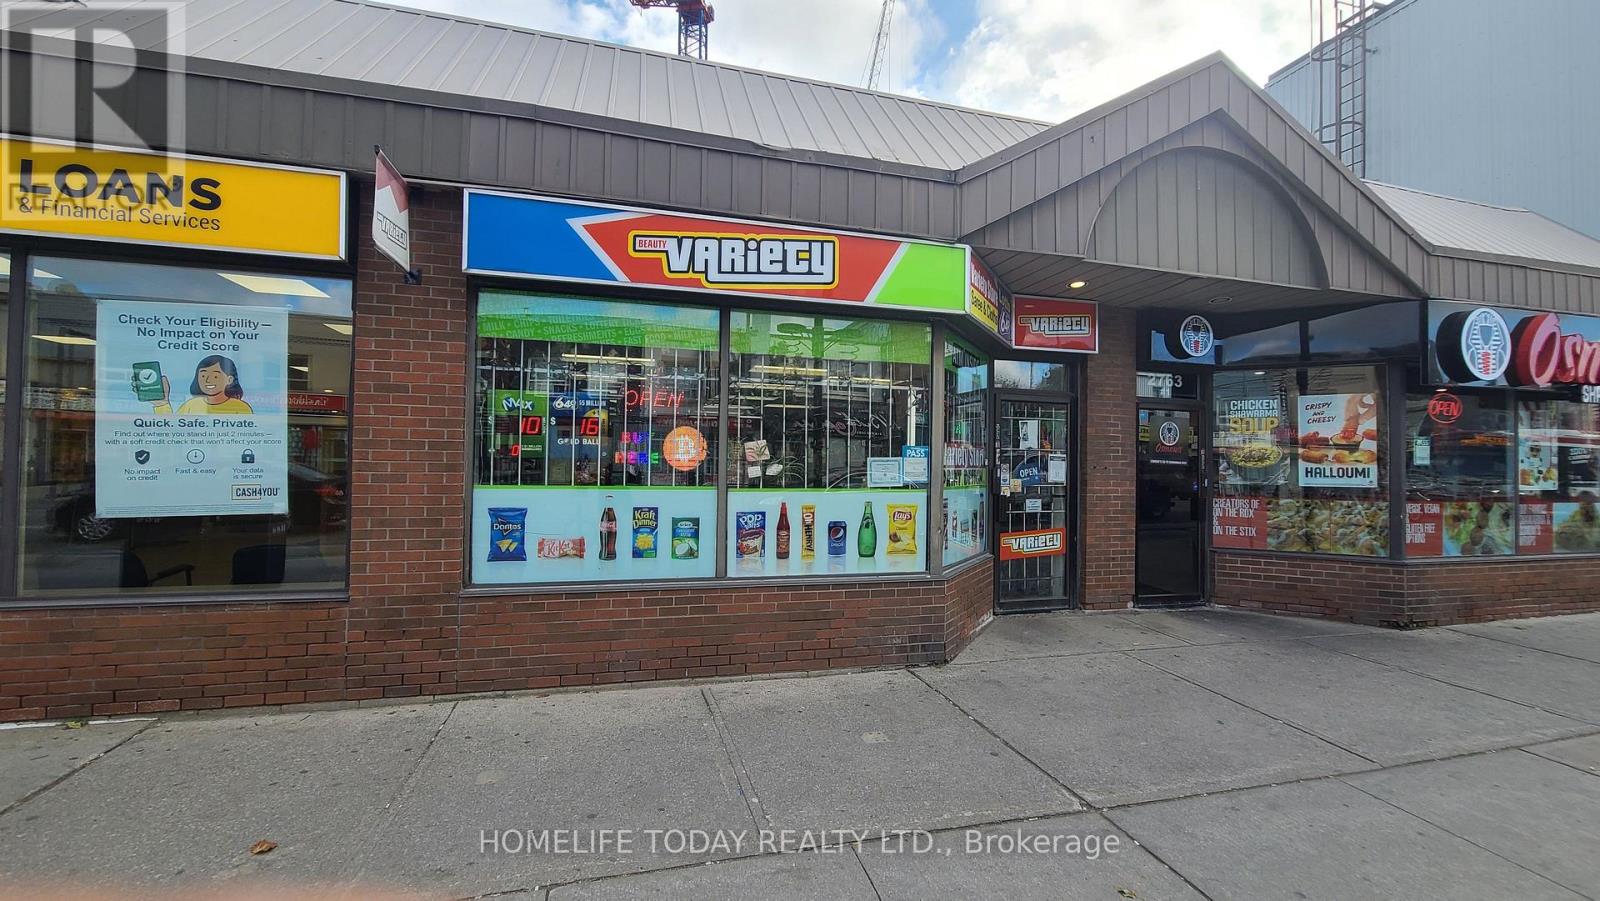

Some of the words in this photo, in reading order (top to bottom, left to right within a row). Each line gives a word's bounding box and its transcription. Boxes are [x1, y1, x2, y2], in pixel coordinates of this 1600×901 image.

[20, 159, 222, 211] LOANS
[19, 197, 33, 213] &
[41, 199, 132, 223] Financial
[139, 208, 220, 231] Services
[638, 239, 667, 249] BEAUTY
[118, 313, 161, 325] Check
[165, 315, 197, 327] Your
[484, 320, 505, 332] MILK
[137, 327, 156, 337] No
[160, 327, 206, 340] Impact
[209, 331, 225, 340] on
[229, 330, 260, 340] Your
[157, 340, 198, 351] Credit
[202, 341, 240, 351] Score
[1148, 375, 1183, 388] 2763
[624, 389, 685, 408] OPEN
[1230, 400, 1278, 410] CHICKEN
[1305, 401, 1332, 411] CRISPY
[1429, 400, 1459, 416] OPEN
[1229, 410, 1279, 418] SHAWARMA
[133, 418, 174, 428] Quick.
[178, 418, 209, 428] Safe.
[212, 418, 257, 428] Private.
[1229, 418, 1280, 434] SOUP
[1307, 416, 1337, 425] CHEESY
[580, 418, 599, 435] 16
[906, 449, 925, 457] PASS
[137, 468, 161, 476] impact
[1019, 466, 1039, 478] OPEN
[1305, 467, 1371, 479] HALLOUMI
[1213, 498, 1250, 508] CREATORS
[1251, 499, 1260, 509] OF
[634, 509, 656, 520] Kraft
[1213, 507, 1223, 517] ON
[1224, 507, 1238, 518] THE
[493, 523, 522, 531] Doritos
[633, 519, 657, 529] Dinner
[1213, 525, 1223, 535] ON
[1224, 526, 1238, 536] THE
[1239, 526, 1257, 537] STIX
